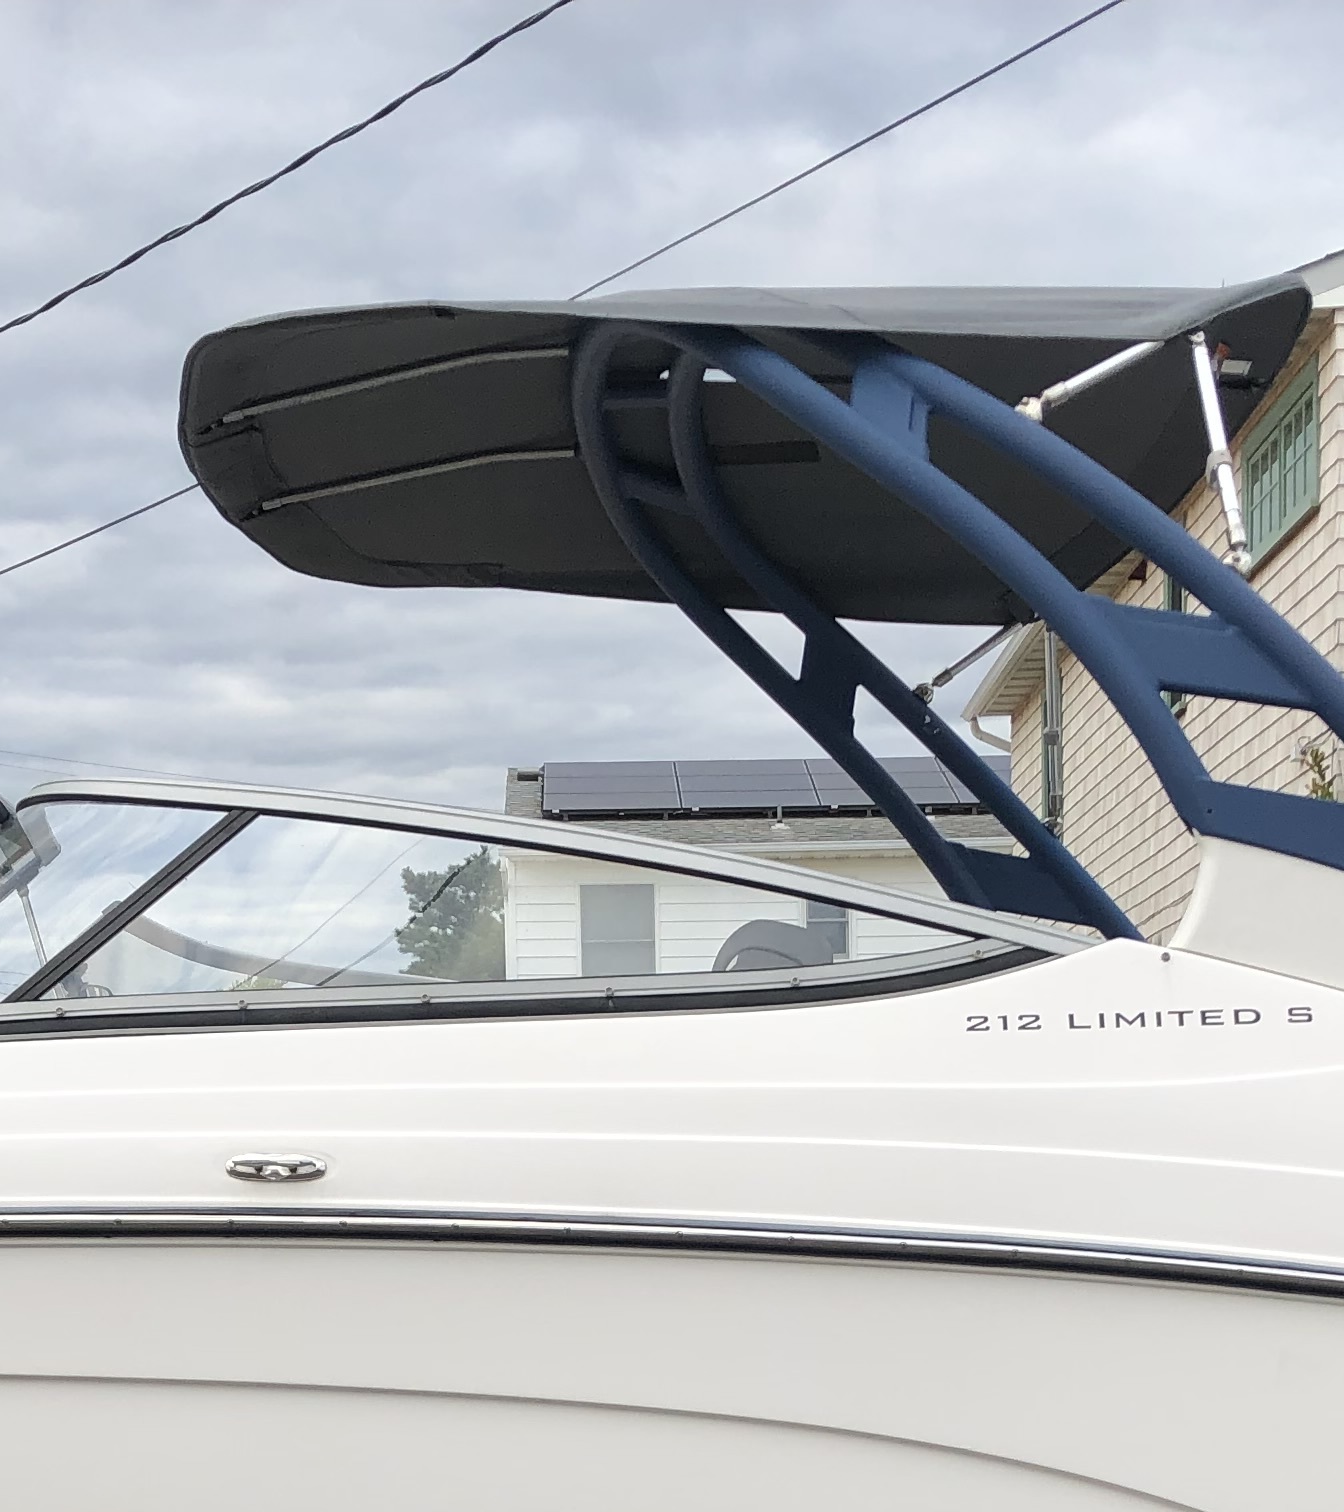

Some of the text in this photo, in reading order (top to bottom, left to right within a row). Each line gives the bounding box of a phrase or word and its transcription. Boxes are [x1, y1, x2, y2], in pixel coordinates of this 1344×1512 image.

[965, 1006, 1314, 1032] 212 LIMITED S
